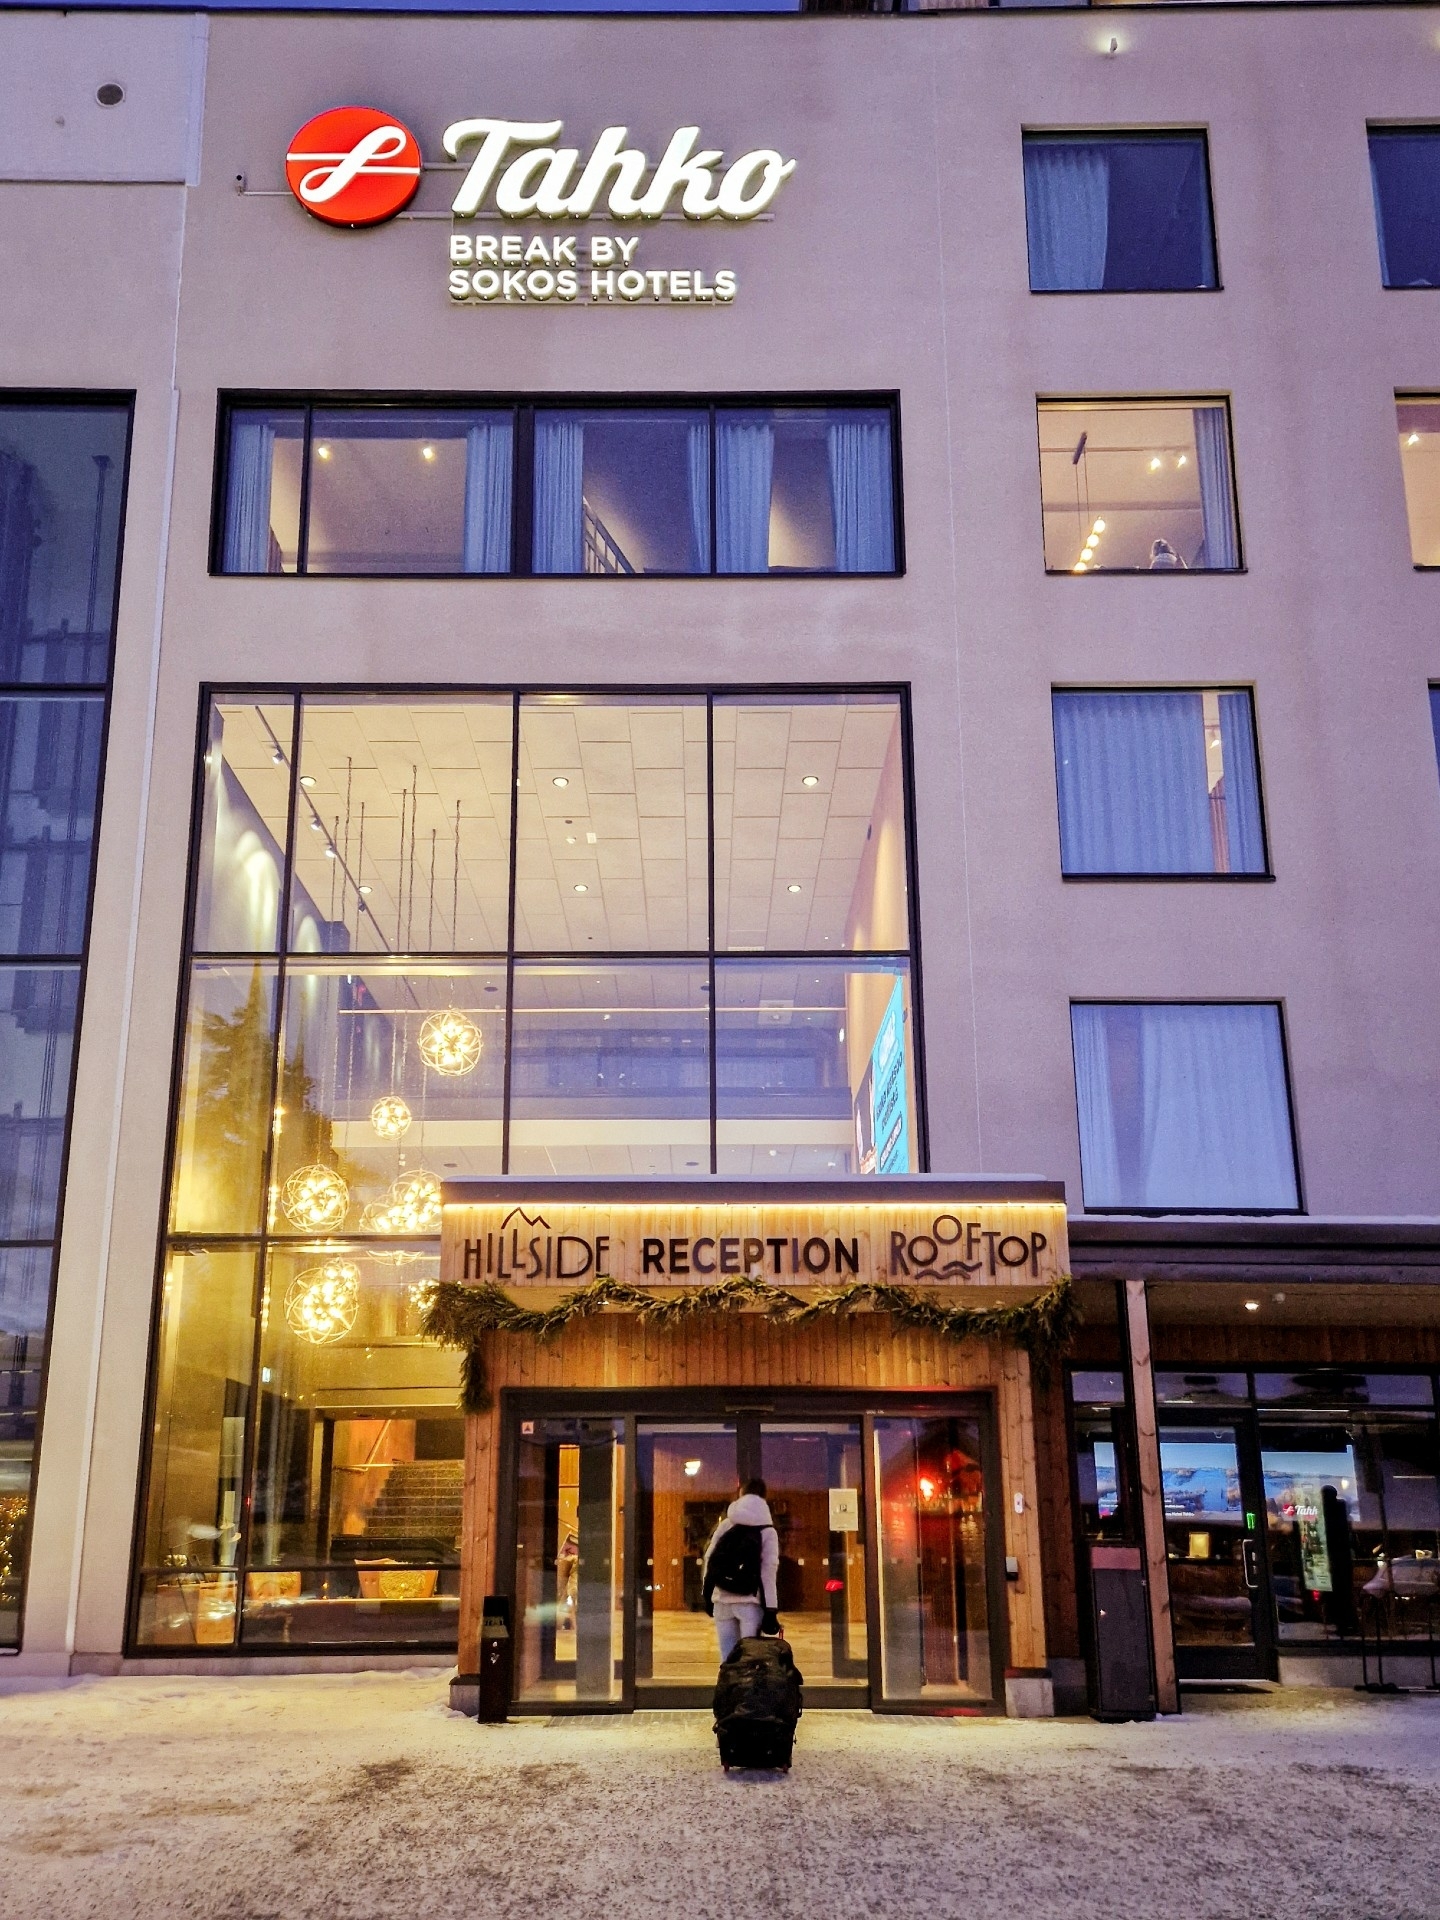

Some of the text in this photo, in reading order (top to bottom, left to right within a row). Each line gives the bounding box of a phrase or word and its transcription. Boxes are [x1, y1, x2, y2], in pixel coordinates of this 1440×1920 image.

[442, 119, 796, 219] Tahko
[449, 235, 639, 266] BREAK BY
[449, 269, 737, 301] SOKOS HOTELS
[463, 1214, 1047, 1279] HILLSIDE RECEPTION ROOFTOP
